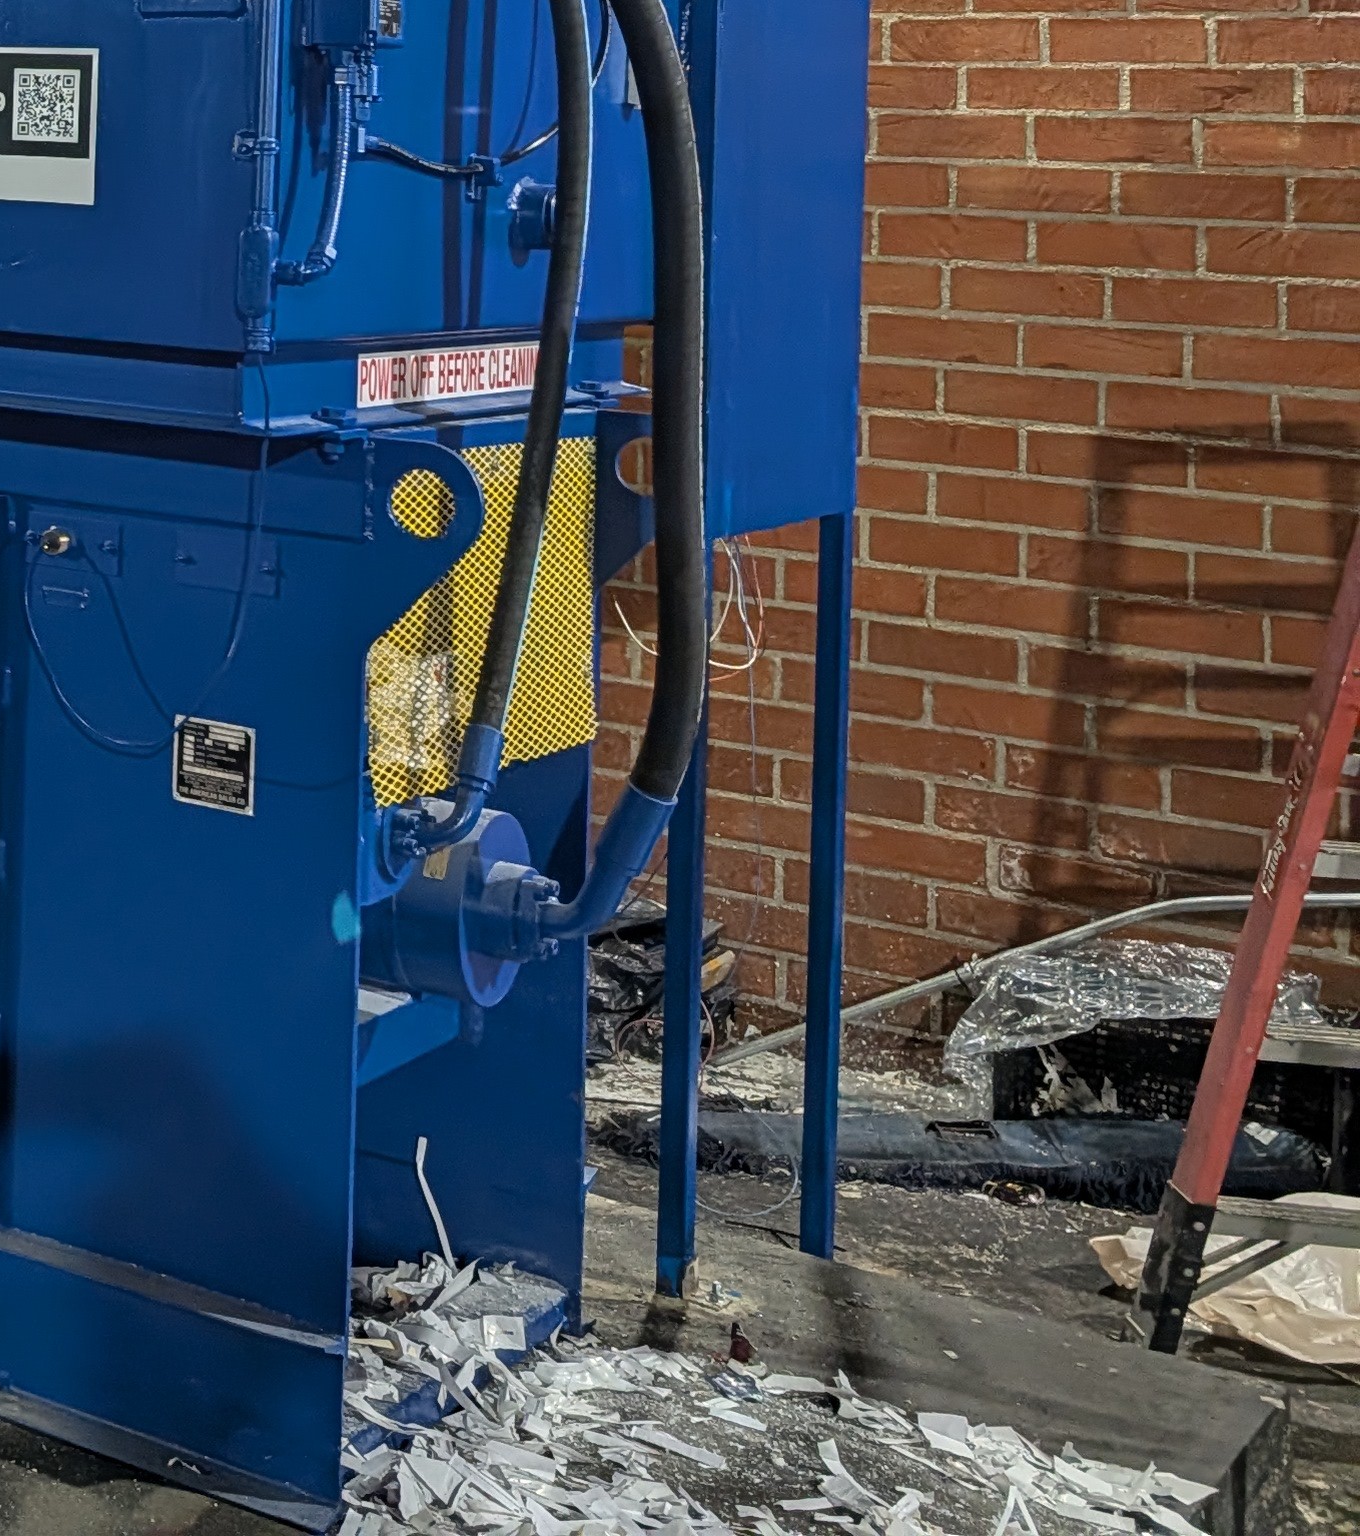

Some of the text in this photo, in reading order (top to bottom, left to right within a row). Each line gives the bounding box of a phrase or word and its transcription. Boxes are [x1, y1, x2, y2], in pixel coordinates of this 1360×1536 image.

[359, 345, 541, 402] POWER OFF BEFORE CLEANIN
